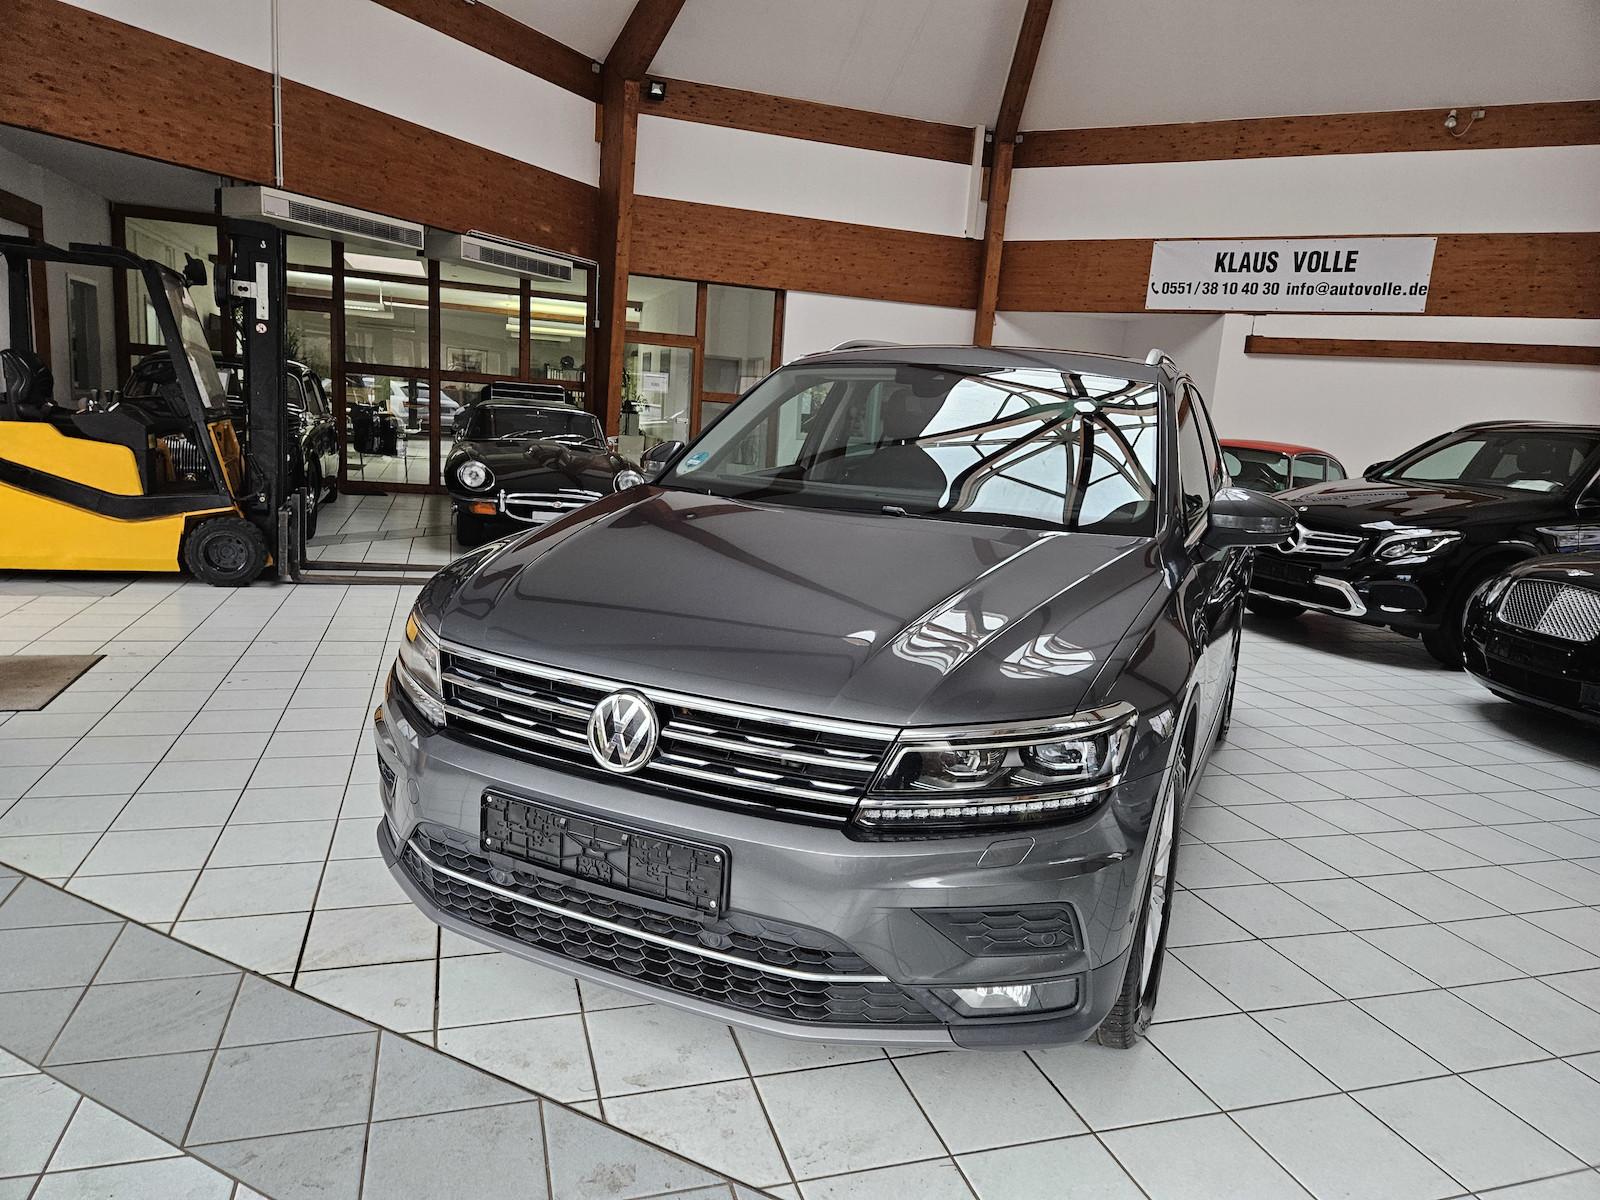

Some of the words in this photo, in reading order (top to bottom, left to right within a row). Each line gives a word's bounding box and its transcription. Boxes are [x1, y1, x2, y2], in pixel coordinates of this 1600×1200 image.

[1214, 251, 1279, 273] KLAUS
[1293, 250, 1359, 273] VOLLE
[1221, 282, 1238, 295] 10
[1241, 282, 1259, 295] 40
[1262, 282, 1280, 295] 30
[1286, 281, 1428, 297] info@autovolle.de
[589, 691, 657, 771] VW
